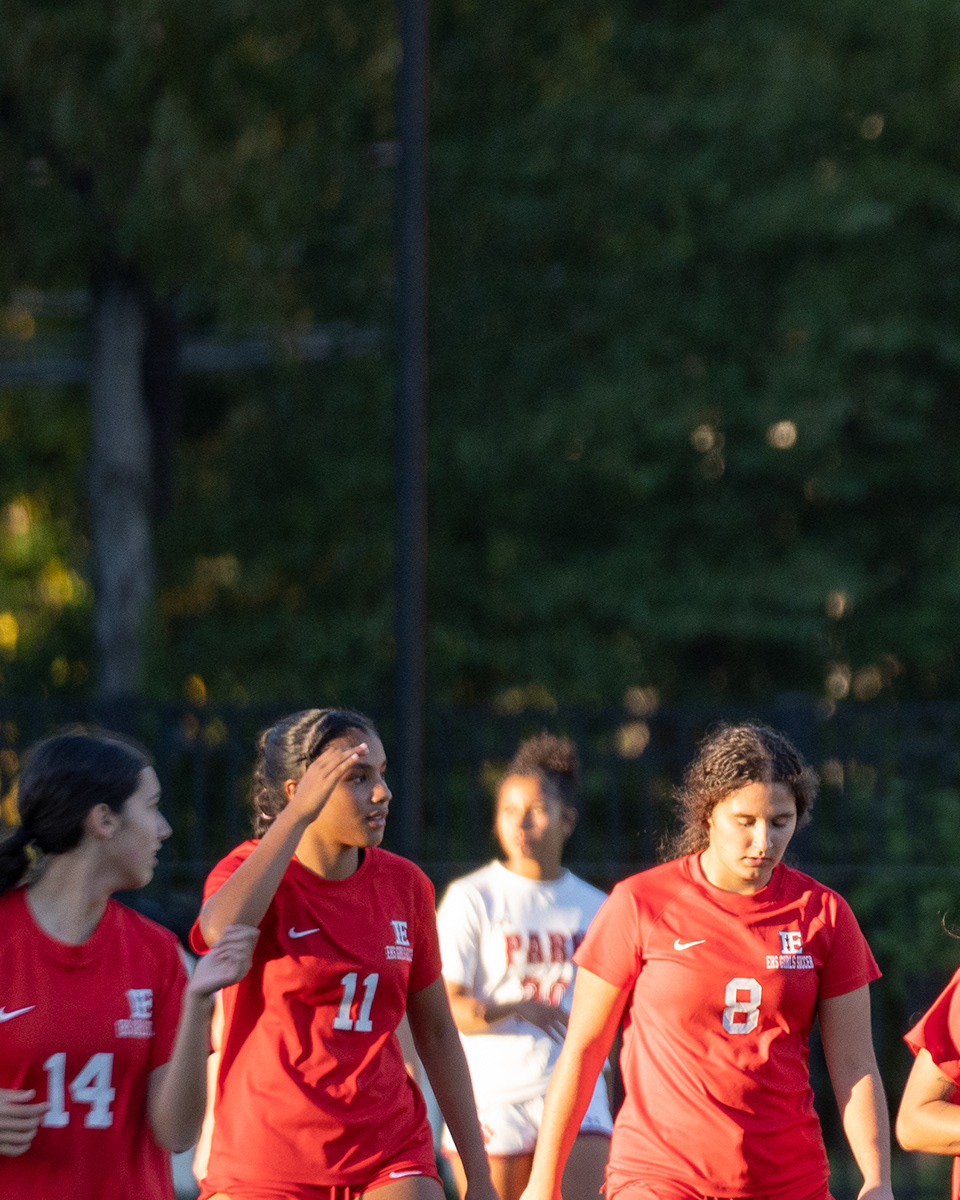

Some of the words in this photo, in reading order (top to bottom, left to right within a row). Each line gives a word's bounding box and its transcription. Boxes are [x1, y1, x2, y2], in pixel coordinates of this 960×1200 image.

[333, 972, 379, 1032] 11
[722, 977, 762, 1035] 8
[41, 1052, 116, 1128] 14
